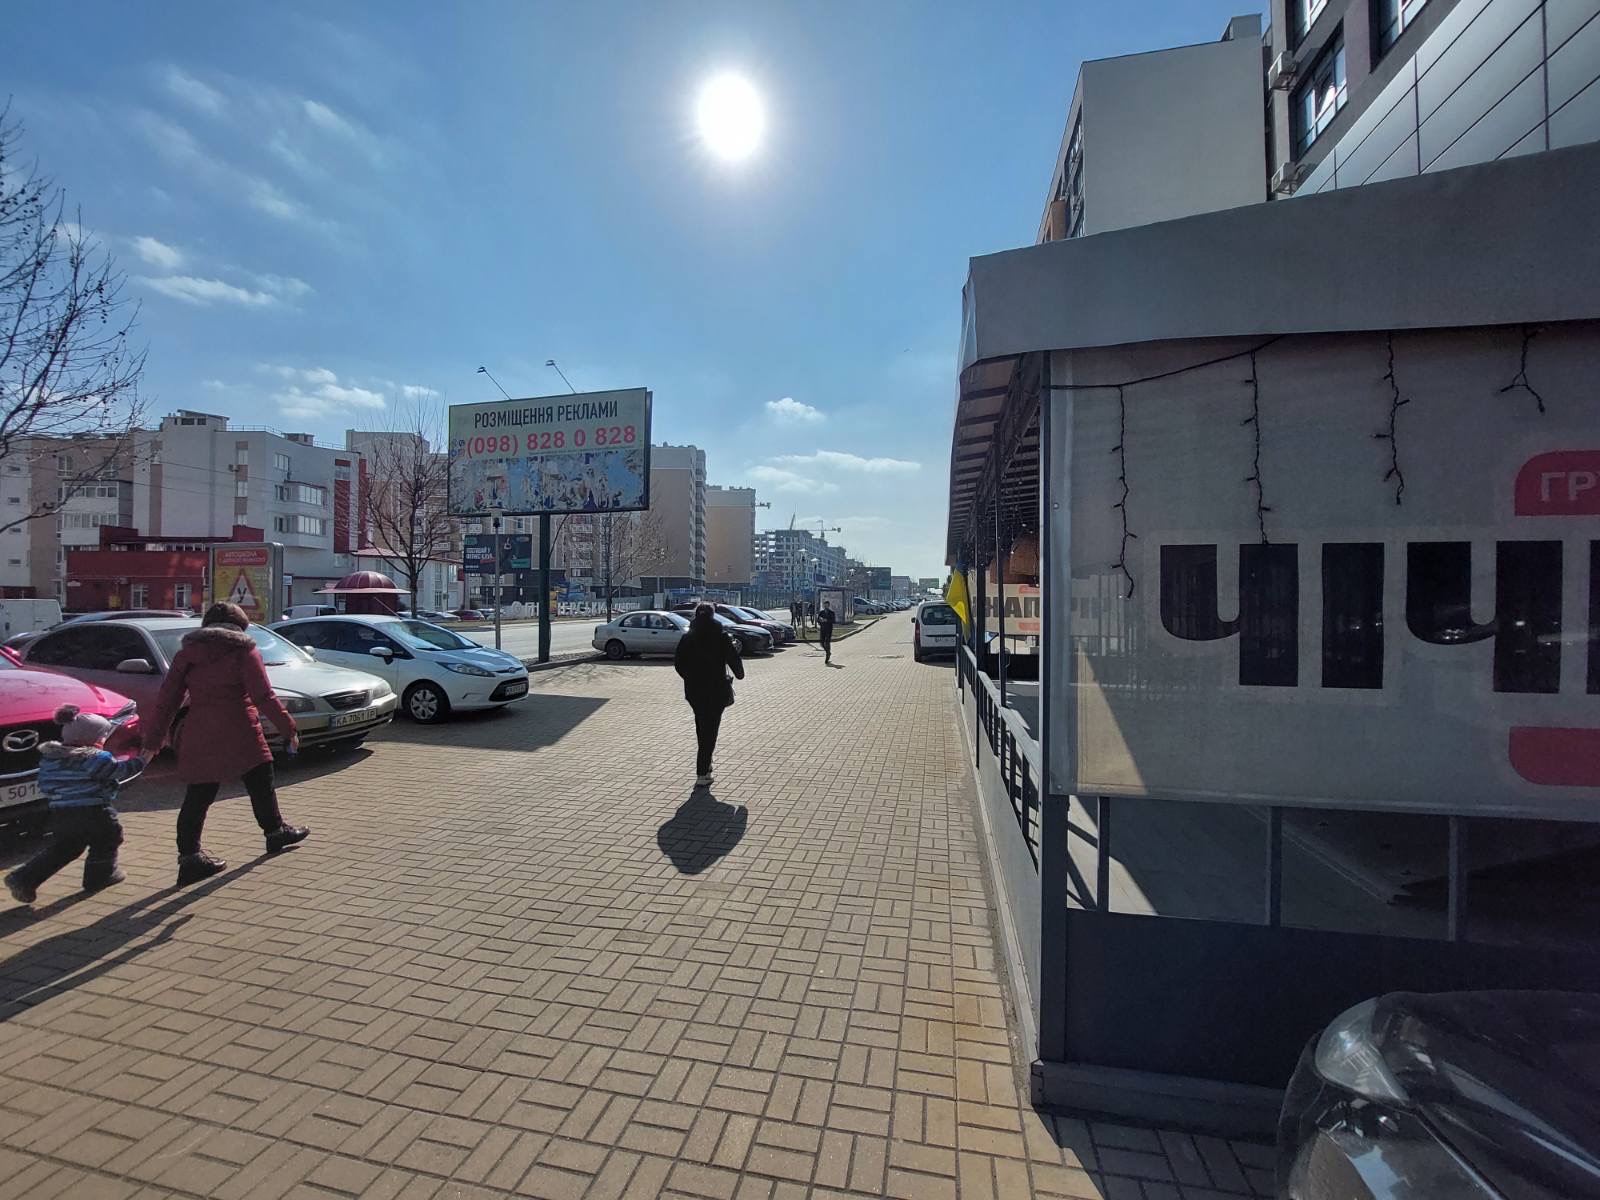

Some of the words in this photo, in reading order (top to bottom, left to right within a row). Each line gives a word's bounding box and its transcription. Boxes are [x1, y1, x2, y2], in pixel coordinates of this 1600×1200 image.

[474, 406, 553, 428] РОЗМІЩЕННЯ
[557, 400, 618, 422] РЕКЛАМИ
[467, 434, 519, 459] (098)
[526, 430, 565, 451] 828
[573, 428, 586, 447] 0
[595, 425, 636, 446] 828
[1160, 540, 1600, 695] ЧІЧ
[8, 783, 40, 800] 501
